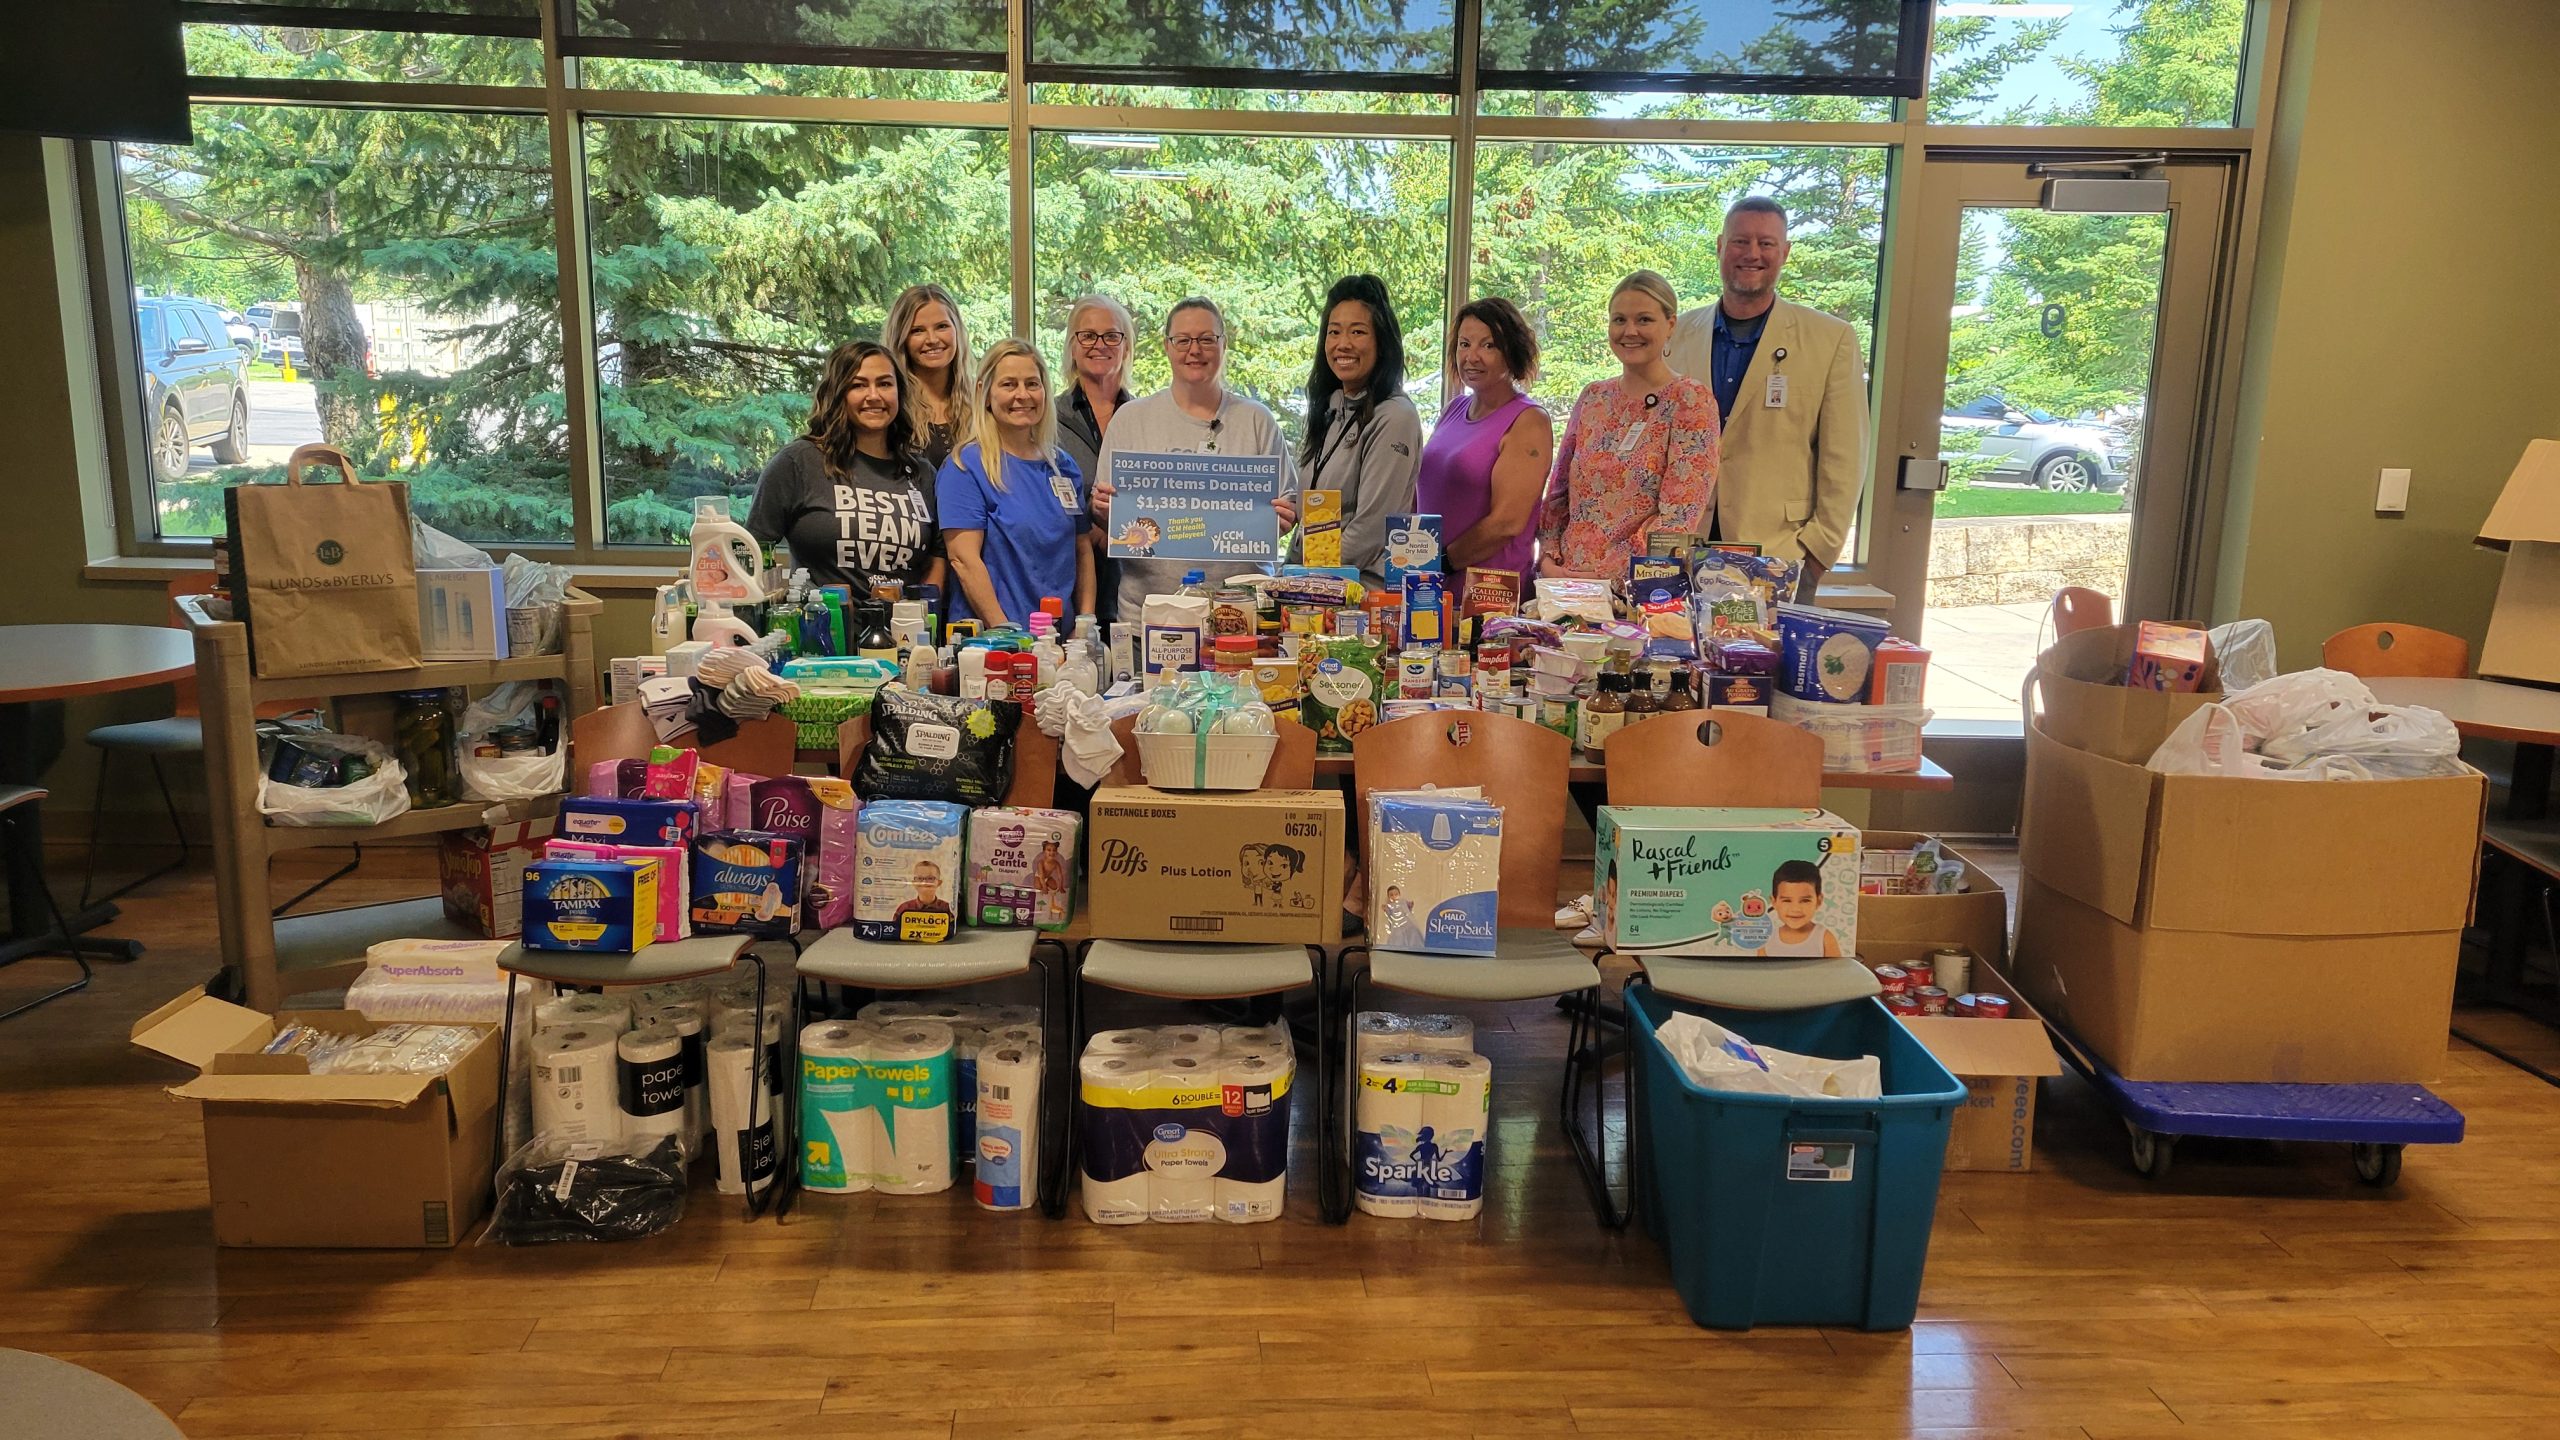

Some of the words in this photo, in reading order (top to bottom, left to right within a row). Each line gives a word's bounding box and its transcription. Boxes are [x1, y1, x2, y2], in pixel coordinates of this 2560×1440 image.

[1115, 459, 1140, 469] 2024
[1143, 460, 1173, 471] FOOD
[1177, 462, 1208, 472] DRIVE
[1212, 463, 1275, 474] CHALLENGE
[1118, 476, 1159, 490] 1,507
[1163, 477, 1205, 490] Items
[1210, 479, 1272, 493] Donated
[1136, 494, 1186, 511] $1,383
[1190, 497, 1253, 511] Donated
[1182, 523, 1206, 531] Health
[1190, 517, 1203, 525] you
[1167, 531, 1206, 541] employees!
[1223, 531, 1244, 540] CCM
[1220, 541, 1270, 554] Health
[698, 560, 725, 570] dreft
[269, 573, 395, 591] LUNDS&BYERLYS
[1470, 587, 1513, 597] SCALLOPED
[1471, 594, 1510, 603] POTATOES
[1320, 680, 1364, 689] Seasoned
[882, 703, 938, 721] SPALDING
[916, 730, 951, 741] SPALDING
[760, 796, 811, 829] Poise
[1104, 808, 1149, 818] RECTANGLE
[1151, 809, 1177, 818] BOXES
[869, 823, 938, 846] Comfees
[1285, 823, 1317, 837] 06730
[571, 834, 606, 844] Maxi
[1820, 840, 1829, 849] 5
[995, 849, 1014, 859] Dry
[1017, 850, 1025, 858] &
[1632, 835, 1697, 862] Rascal
[991, 858, 1028, 868] Gentle
[1100, 838, 1149, 877] Puffs
[525, 872, 540, 881] 96
[1161, 866, 1186, 877] Plus
[1191, 866, 1232, 878] Lotion
[714, 866, 770, 891] always
[553, 899, 600, 910] TAMPAX
[999, 909, 1009, 922] 5
[1444, 913, 1466, 921] HALO
[1429, 919, 1493, 939] SleepSack
[1630, 925, 1639, 933] 64
[381, 964, 464, 977] SuperAbsorb
[641, 1063, 683, 1087] pape
[803, 1060, 859, 1083] Paper
[866, 1065, 930, 1082] Towels
[1366, 1078, 1372, 1086] 2
[1383, 1078, 1397, 1093] 4
[641, 1084, 683, 1105] towe
[1172, 1095, 1180, 1105] 6
[1181, 1092, 1214, 1102] DOUBLE
[1224, 1091, 1241, 1104] 12
[1157, 1127, 1180, 1136] Great
[1154, 1148, 1178, 1158] Ultra
[1181, 1148, 1215, 1159] Strong
[1160, 1159, 1183, 1168] Paper
[1184, 1158, 1209, 1167] Towels
[1366, 1157, 1452, 1185] Sparkle
